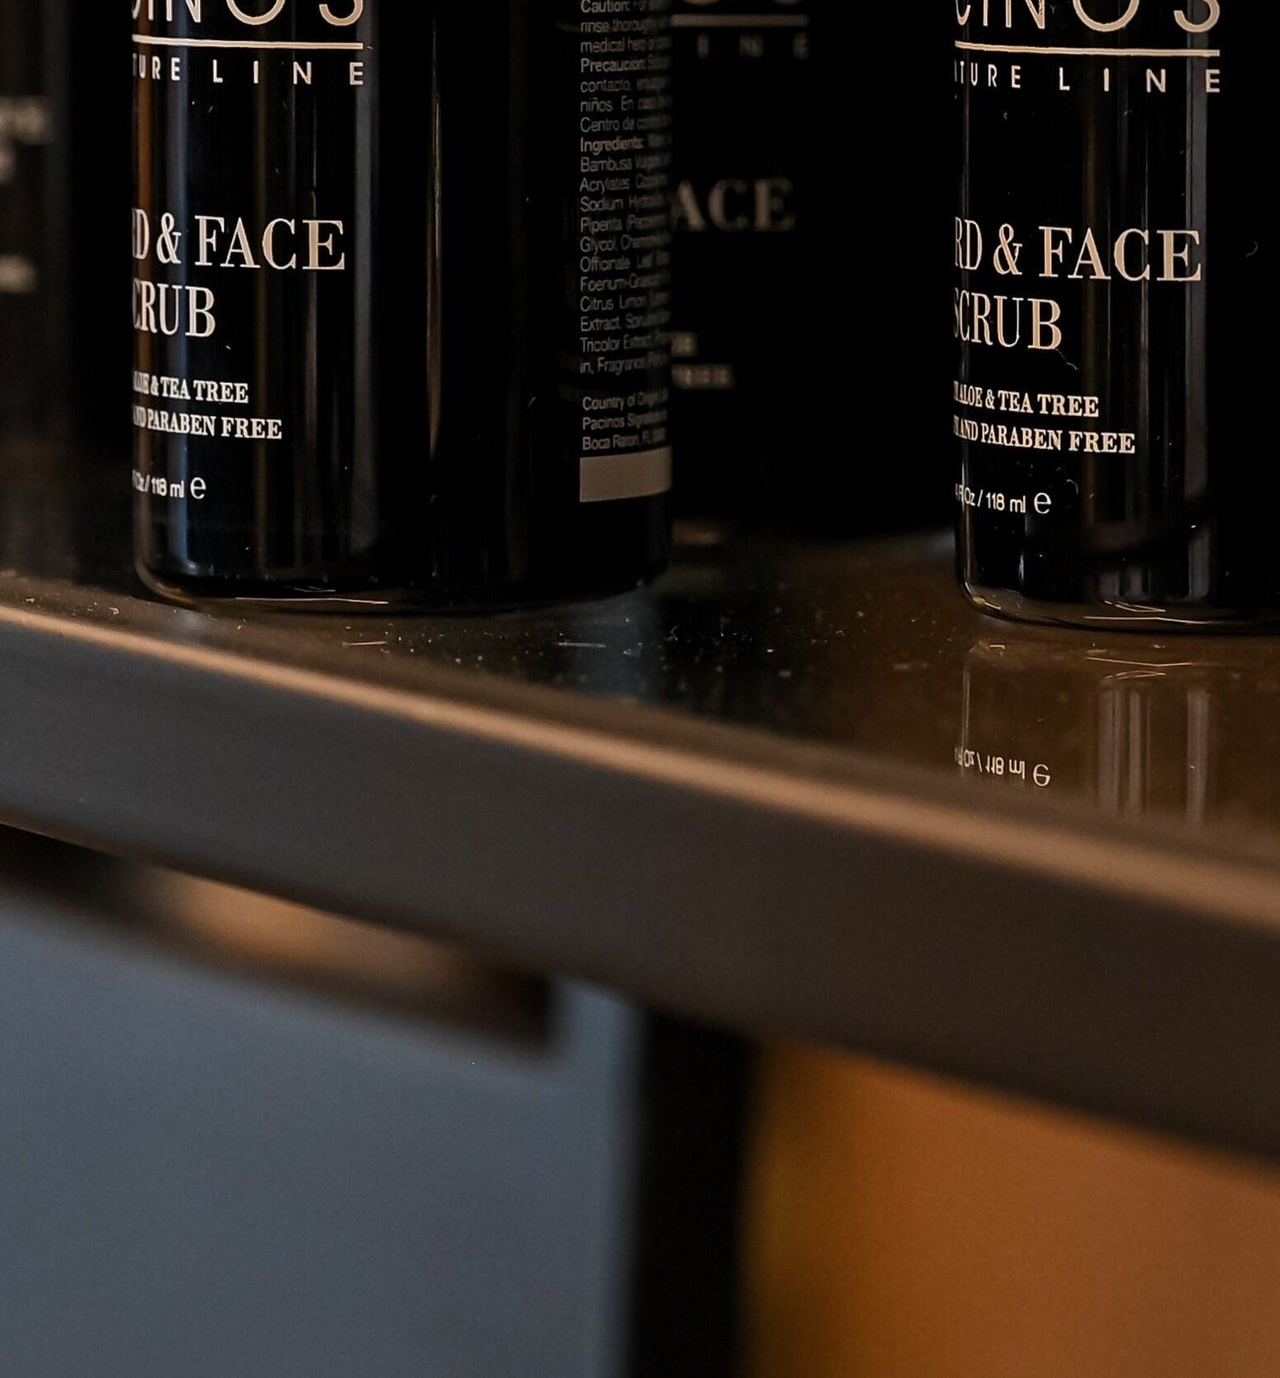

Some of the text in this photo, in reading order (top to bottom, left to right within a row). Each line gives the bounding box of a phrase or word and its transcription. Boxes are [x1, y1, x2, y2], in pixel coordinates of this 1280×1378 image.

[212, 58, 363, 86] LINE
[1058, 67, 1220, 94] LINE
[580, 116, 620, 133] Centro
[156, 212, 182, 264] &
[194, 215, 345, 270] FACE
[993, 223, 1023, 275] &
[1038, 226, 1202, 281] FACE
[160, 376, 191, 400] TEA
[193, 380, 249, 404] TREE
[582, 396, 624, 412] Country
[985, 388, 995, 410] &
[997, 389, 1034, 414] TEA
[1037, 393, 1099, 418] TREE
[147, 408, 216, 437] PARABEN
[220, 416, 282, 440] FREE
[582, 435, 611, 451] Boca
[980, 422, 1063, 451] PARABEN
[1068, 430, 1136, 455] FREE
[986, 491, 1005, 512] 118
[1009, 495, 1026, 514] ml
